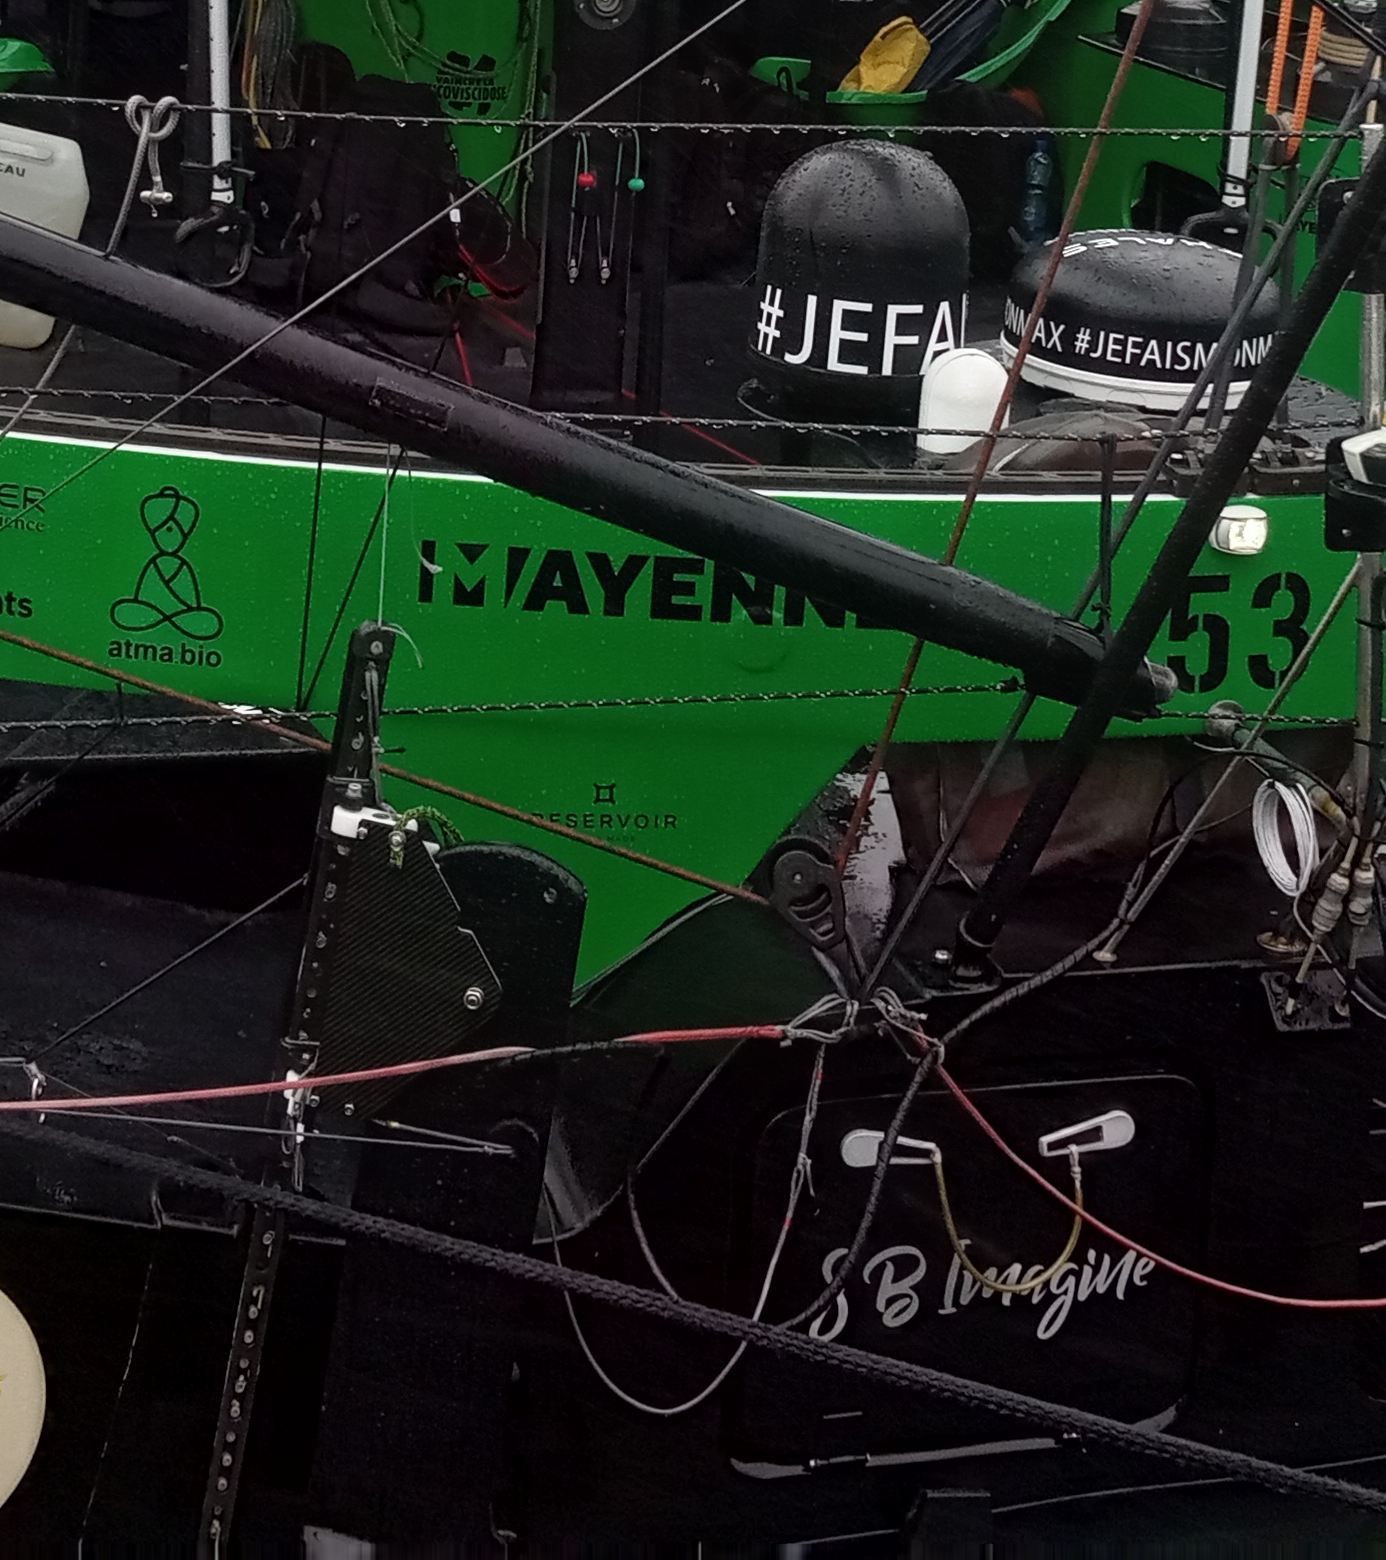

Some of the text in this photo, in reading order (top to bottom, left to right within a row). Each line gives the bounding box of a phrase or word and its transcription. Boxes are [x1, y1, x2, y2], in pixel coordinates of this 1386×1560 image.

[432, 85, 507, 101] COVISCIDOSE
[417, 539, 905, 630] MAYENN
[108, 638, 223, 669] atma.bio
[1166, 571, 1311, 694] 53
[937, 1238, 1157, 1341] Imagine
